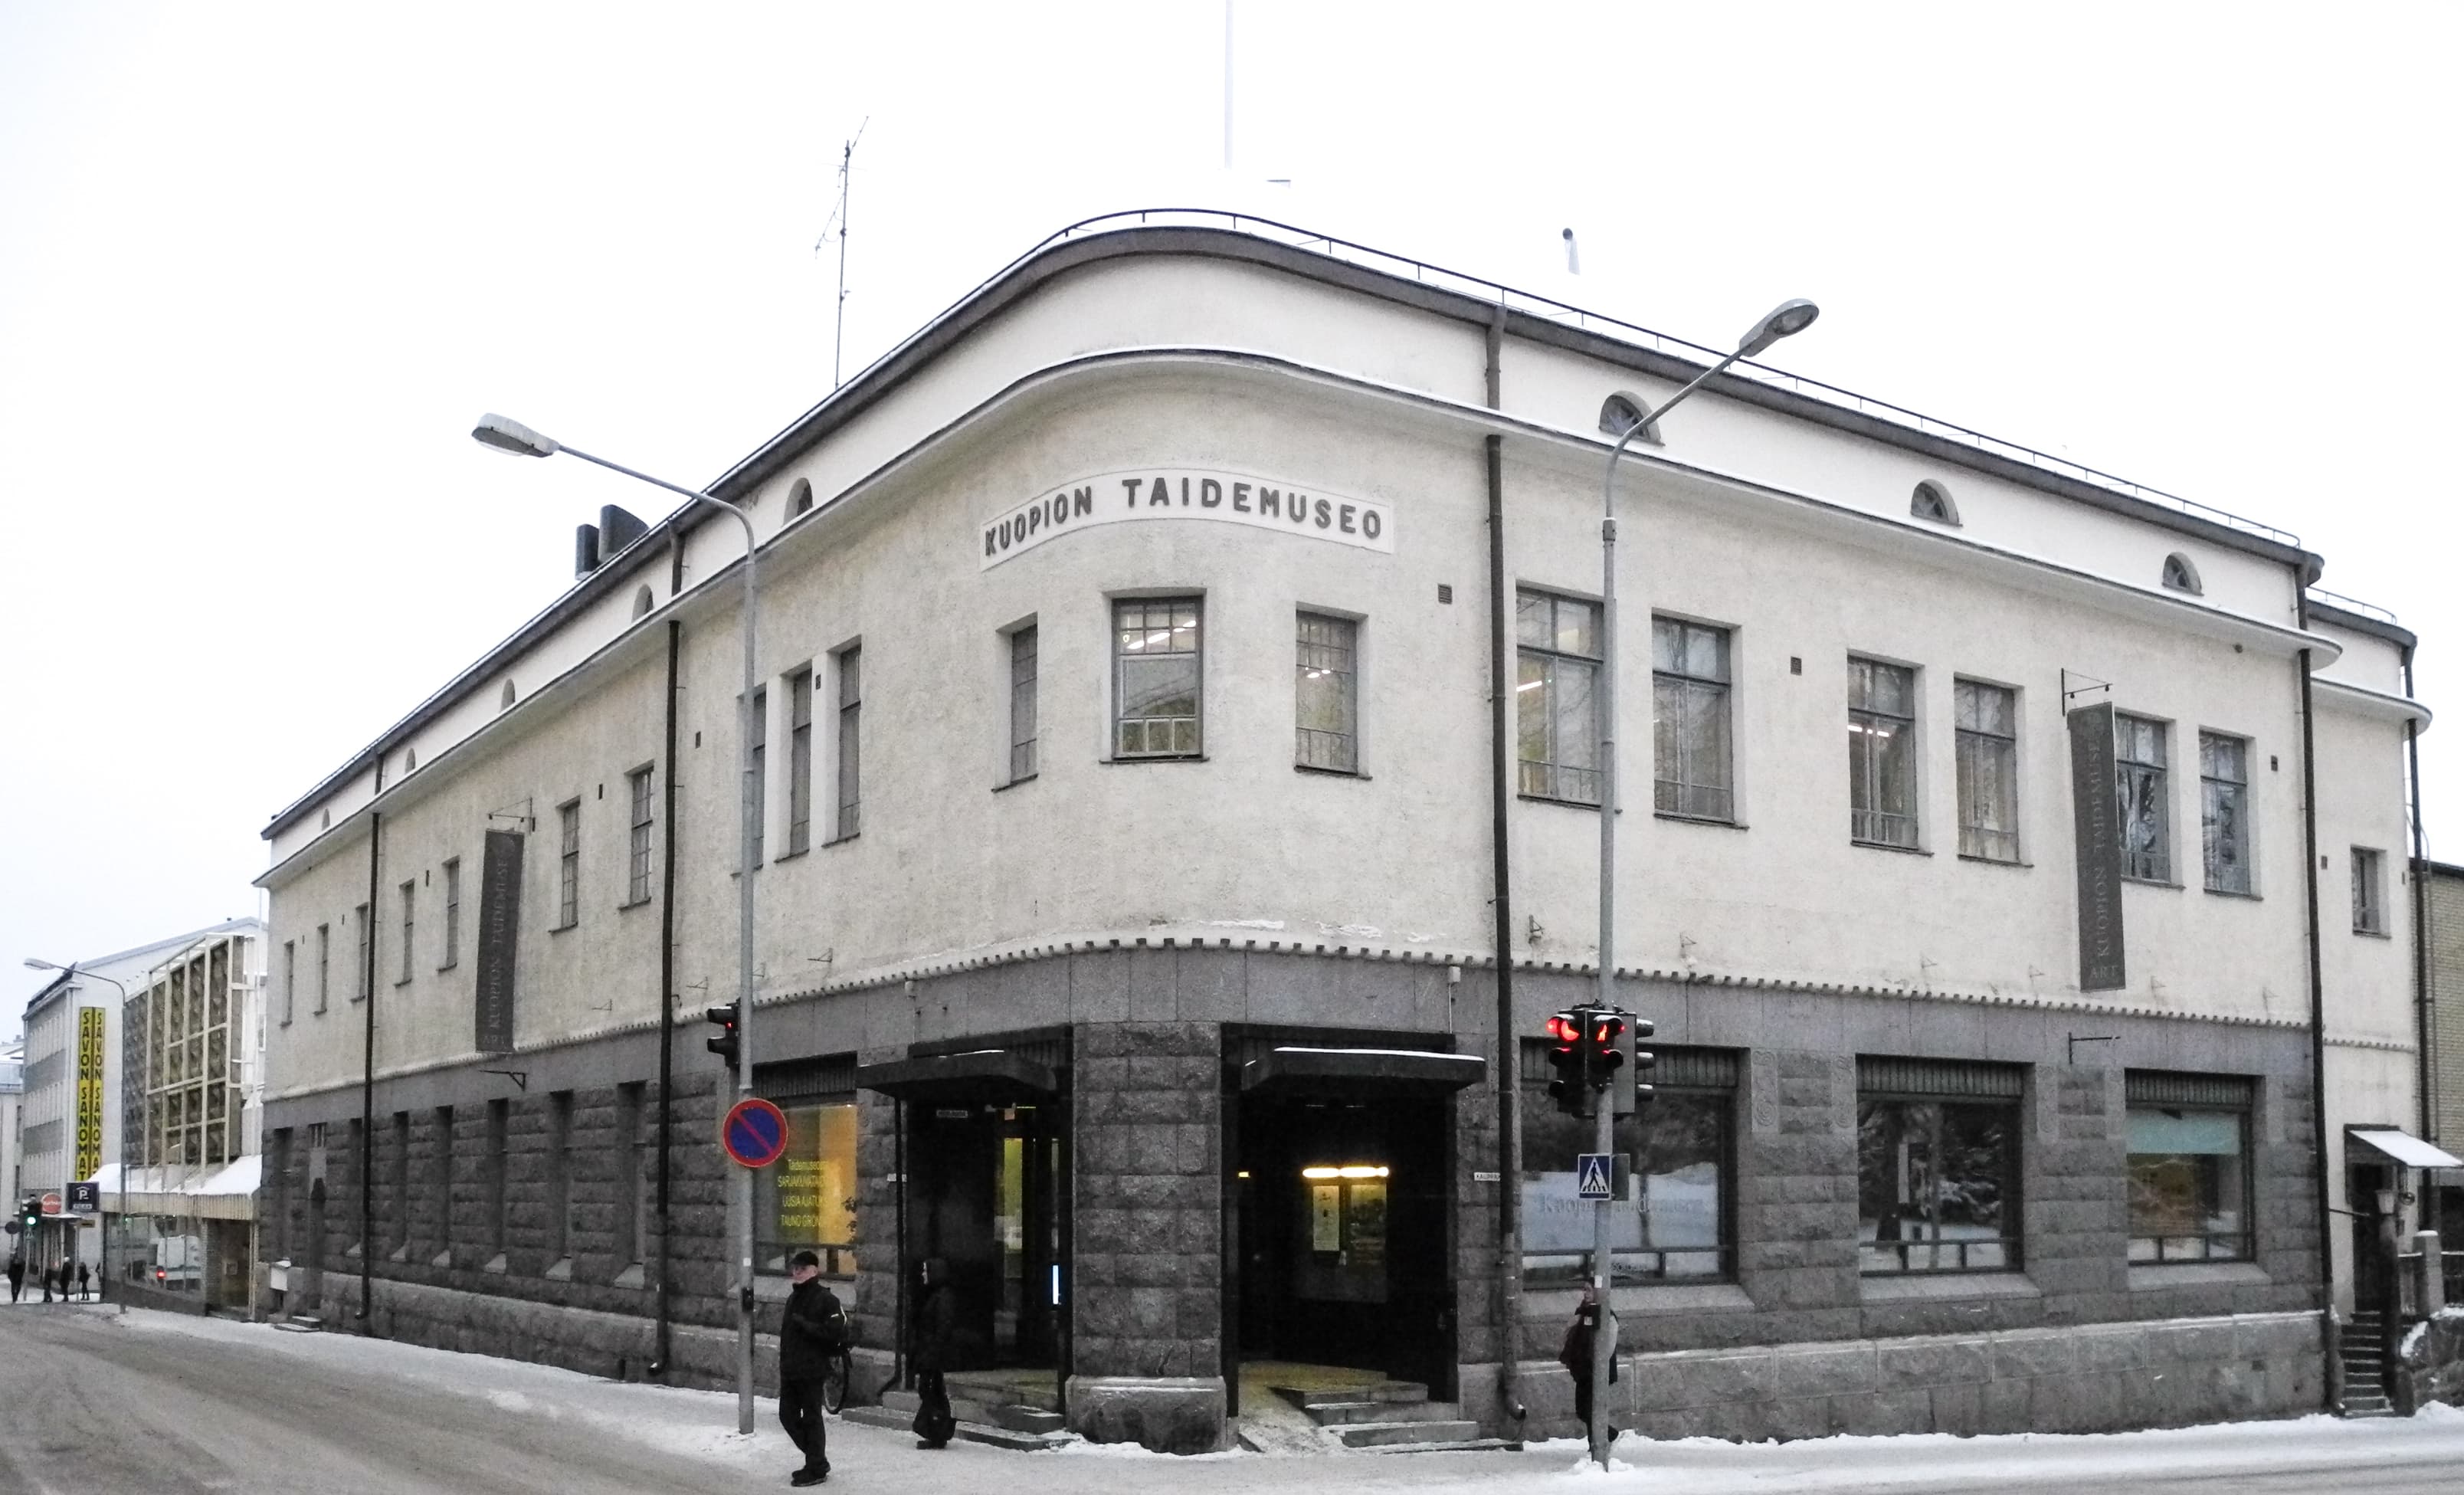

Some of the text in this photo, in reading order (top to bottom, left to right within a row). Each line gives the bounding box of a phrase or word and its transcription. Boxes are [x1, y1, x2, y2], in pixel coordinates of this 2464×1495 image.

[985, 477, 1381, 557] KUOPION TAIDEMUSEO
[2095, 866, 2110, 957] KUOPION
[489, 952, 503, 1029] KUOPION
[2090, 965, 2118, 979] ART
[77, 1011, 90, 1180] SAVON SANOMAT
